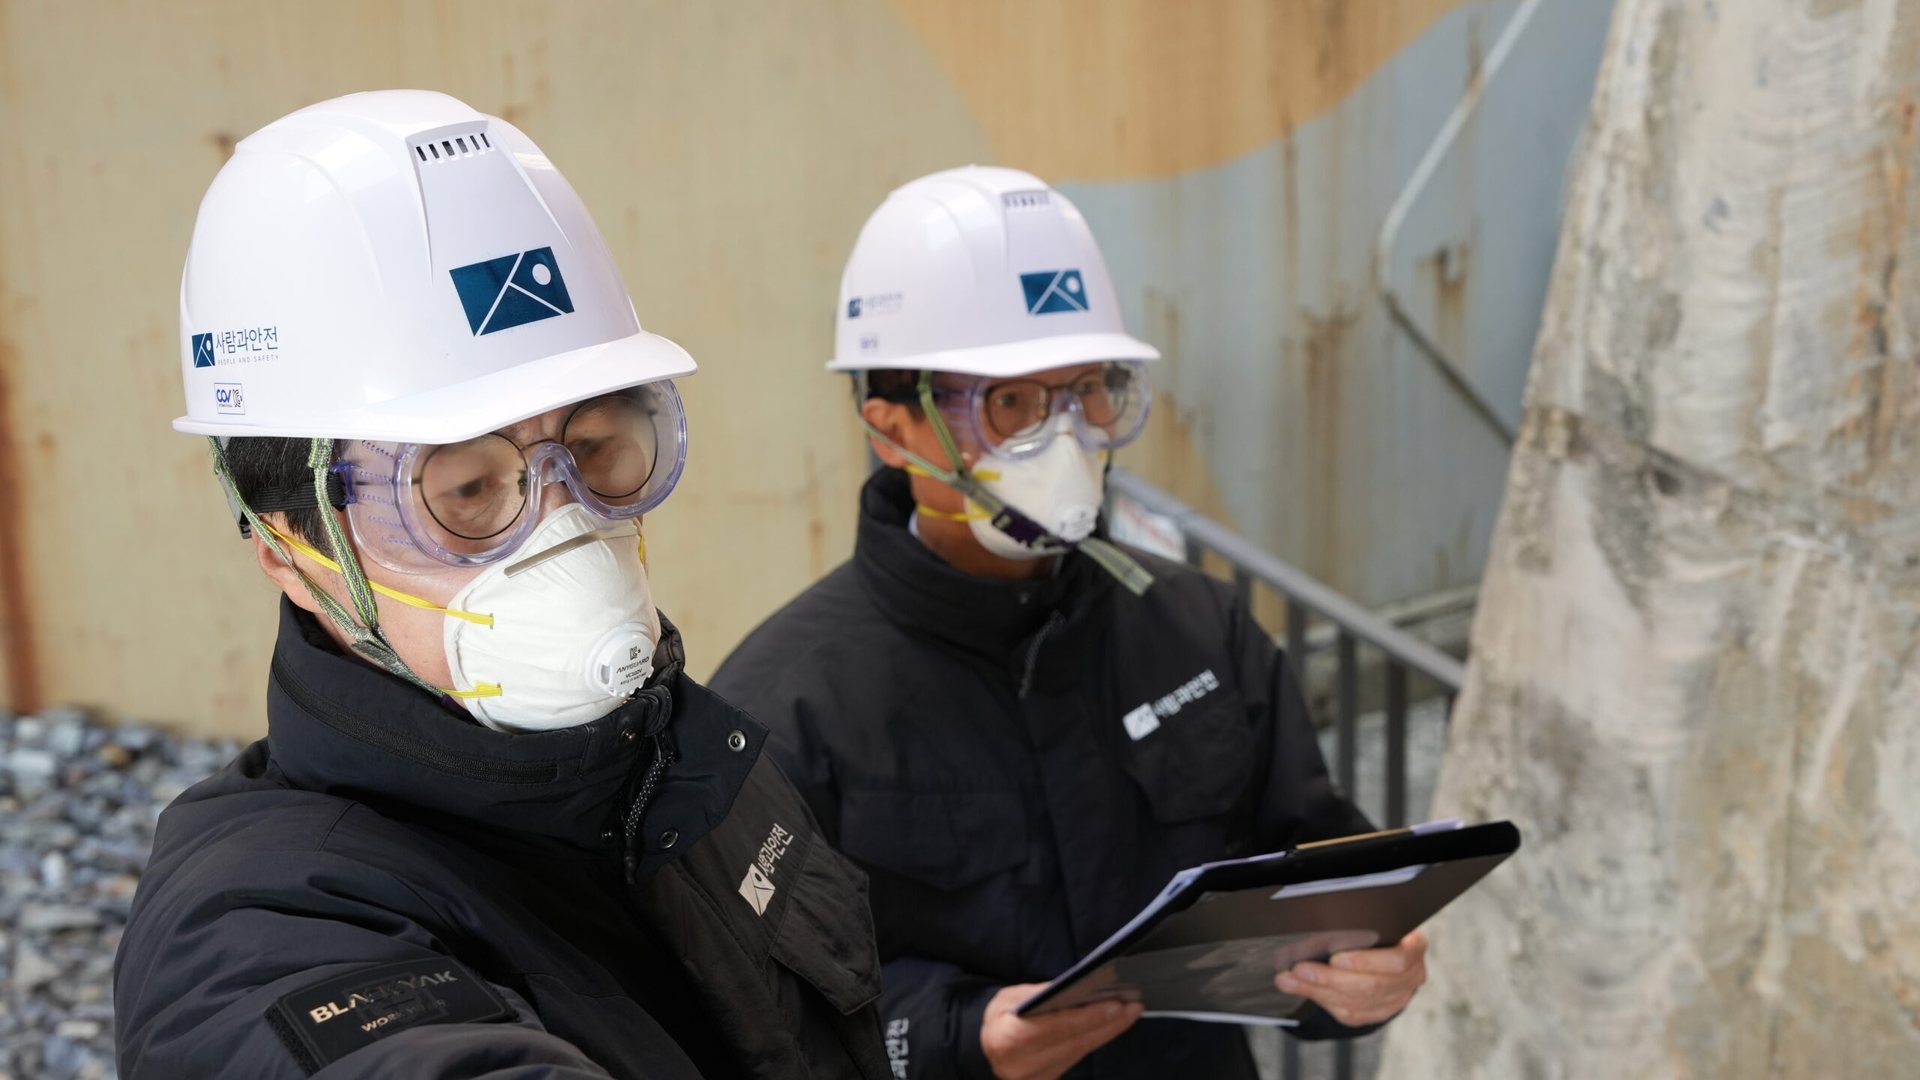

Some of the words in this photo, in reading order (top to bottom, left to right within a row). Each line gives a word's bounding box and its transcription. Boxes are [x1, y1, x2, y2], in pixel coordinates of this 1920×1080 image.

[216, 326, 278, 354] 사람과안전
[217, 358, 236, 366] PEOPLE
[254, 354, 279, 363] SAFETY
[757, 822, 794, 877] 사람과안전
[308, 970, 458, 1024] BLAKYAK
